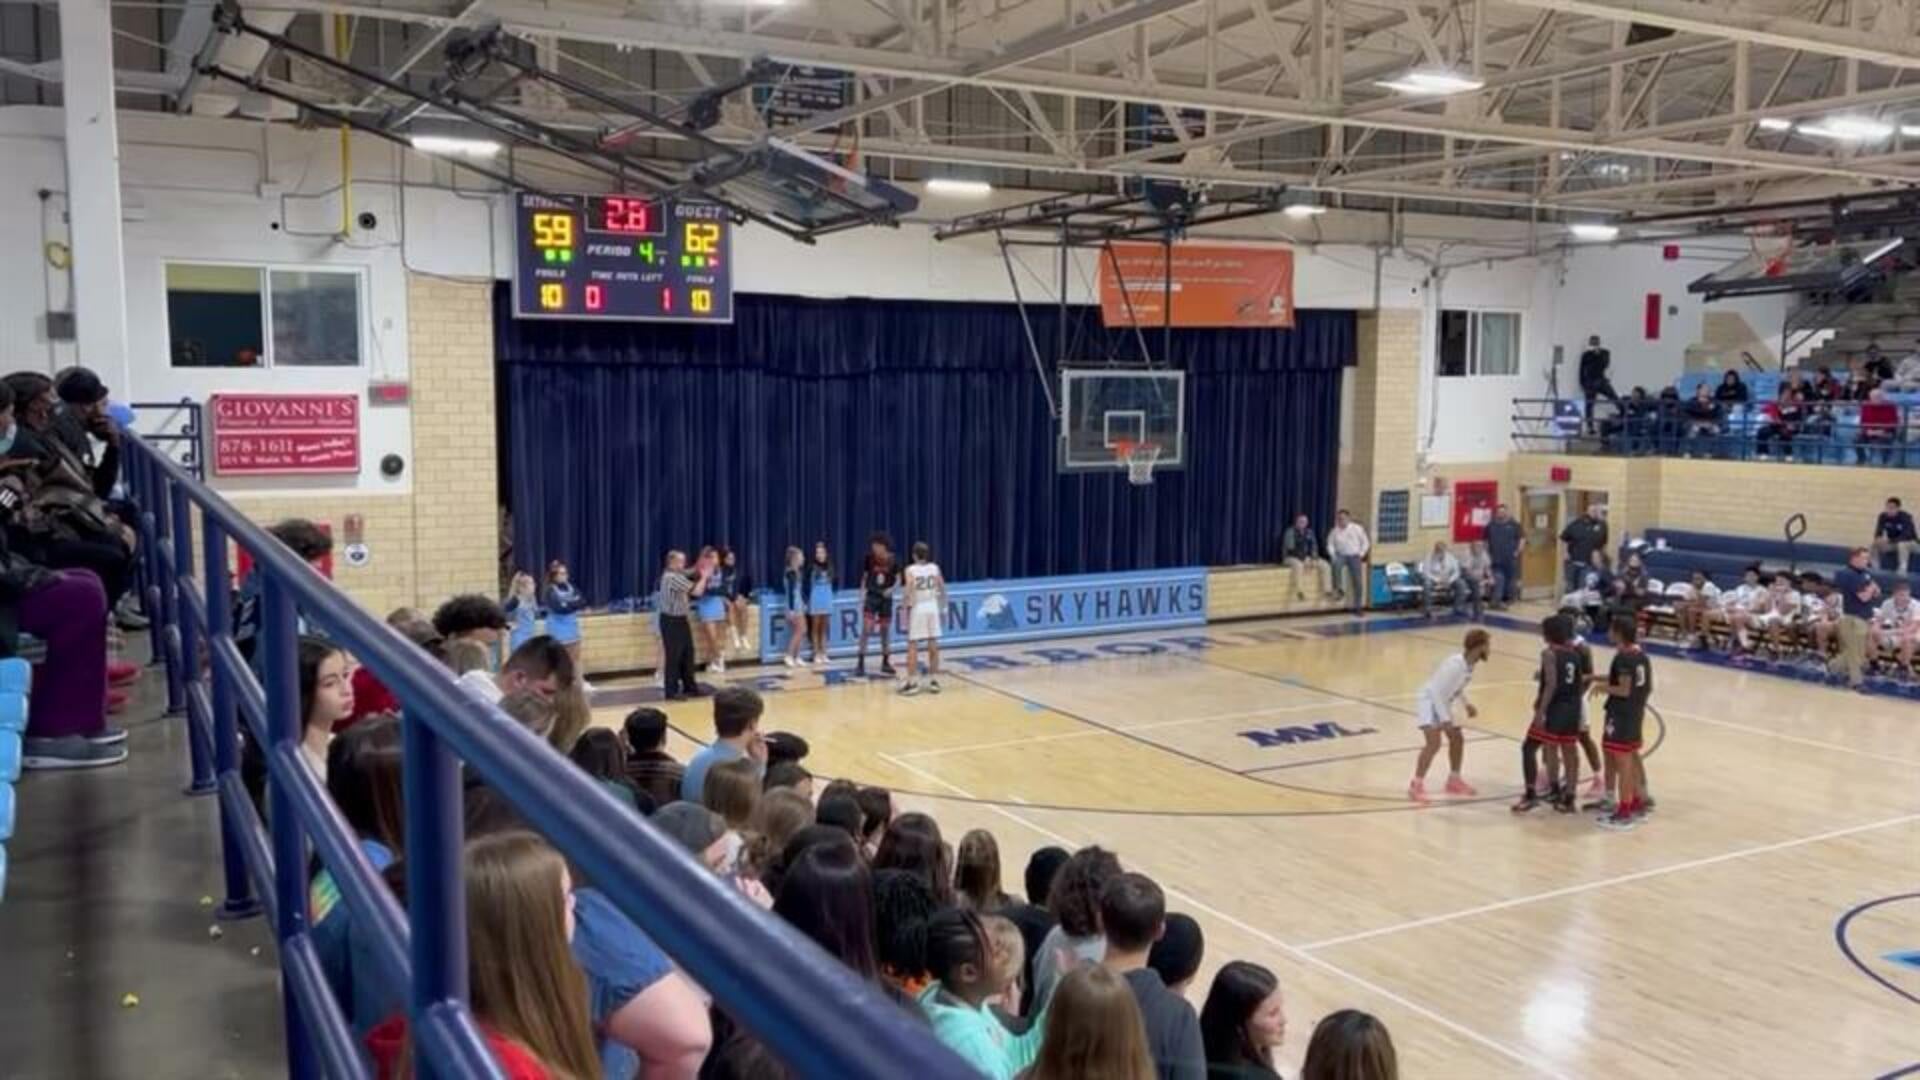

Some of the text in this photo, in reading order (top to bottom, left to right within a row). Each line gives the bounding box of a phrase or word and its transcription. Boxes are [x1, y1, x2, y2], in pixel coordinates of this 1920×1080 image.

[533, 213, 572, 247] 59
[685, 222, 719, 253] 62
[586, 241, 653, 264] PERIOD 4
[541, 283, 563, 309] 10
[585, 285, 601, 310] 0
[662, 287, 670, 311] 1
[691, 289, 711, 312] 10
[217, 401, 353, 417] GIOVANNI'S
[220, 439, 294, 453] 878-1611
[1026, 583, 1203, 625] SKYHAWKS
[1565, 661, 1576, 684] 3
